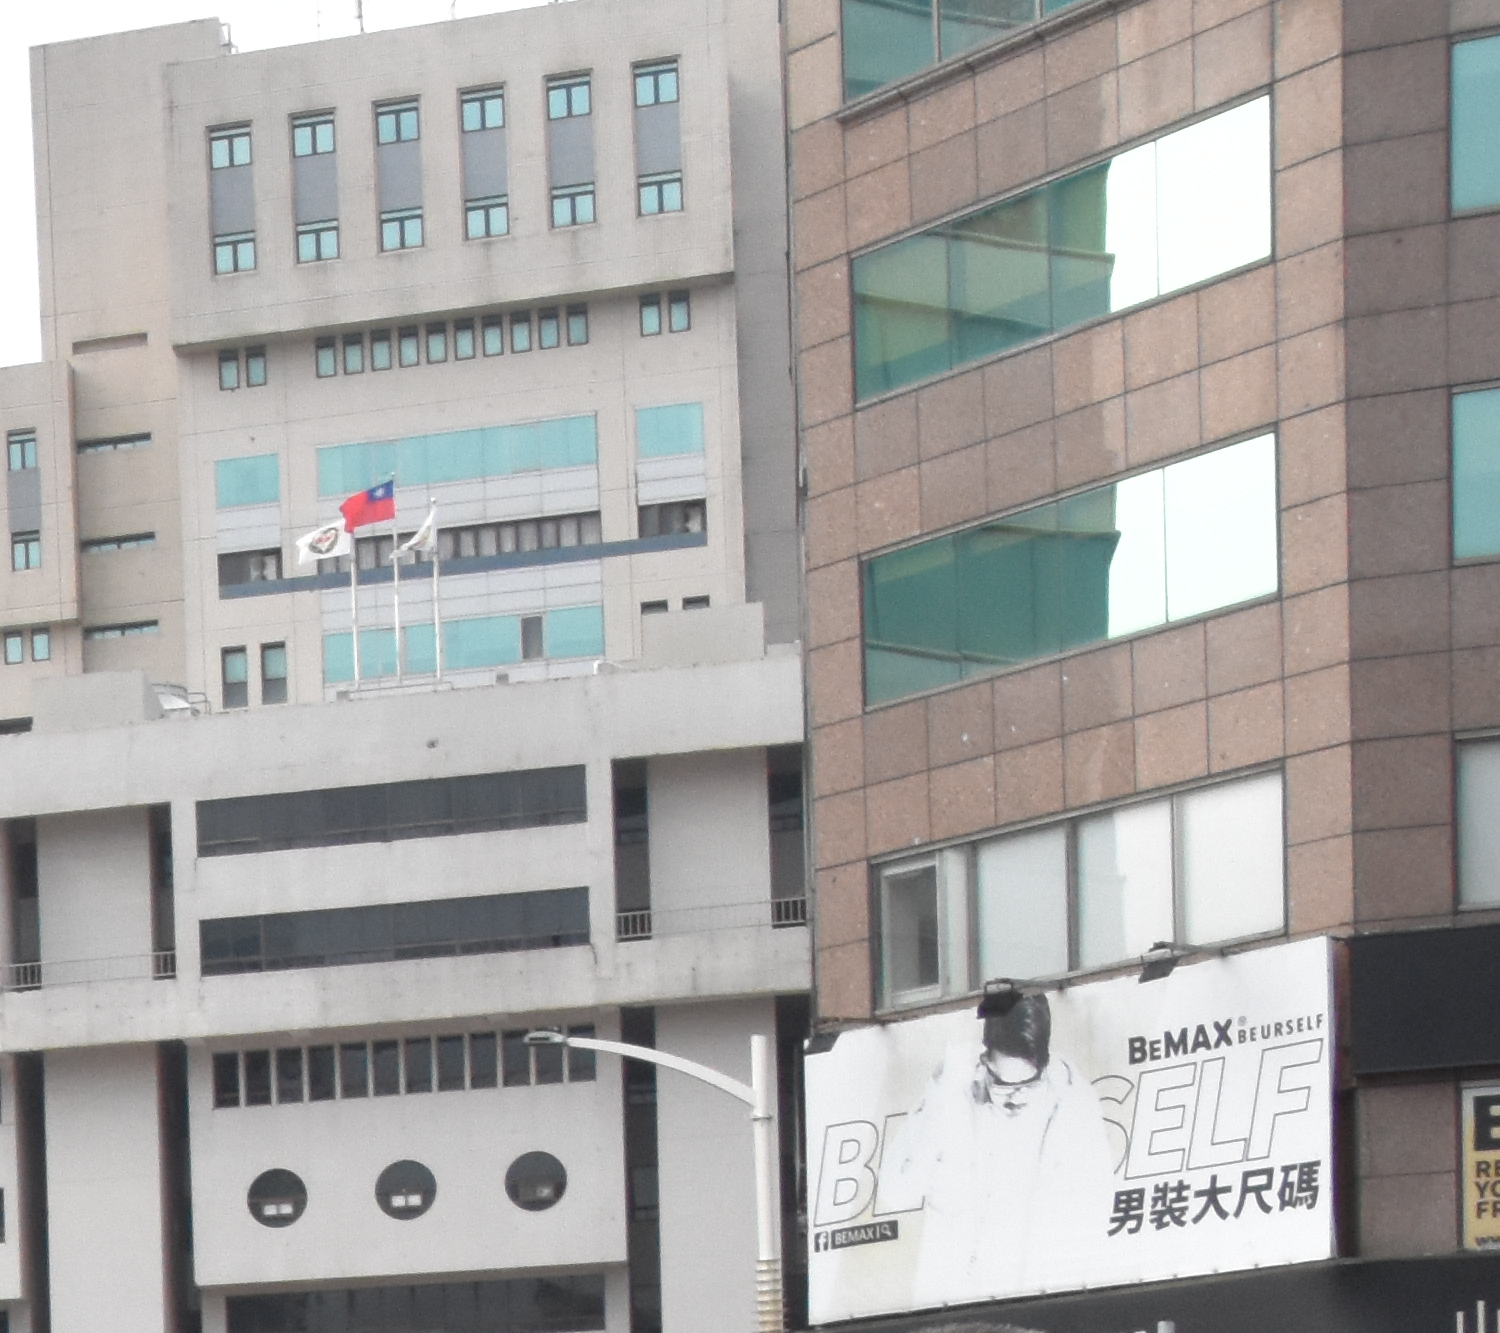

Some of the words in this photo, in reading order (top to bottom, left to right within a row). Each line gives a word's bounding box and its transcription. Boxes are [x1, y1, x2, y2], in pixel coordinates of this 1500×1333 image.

[1107, 1161, 1322, 1236] 男裝大尺碼
[834, 1226, 875, 1245] BEMAX
